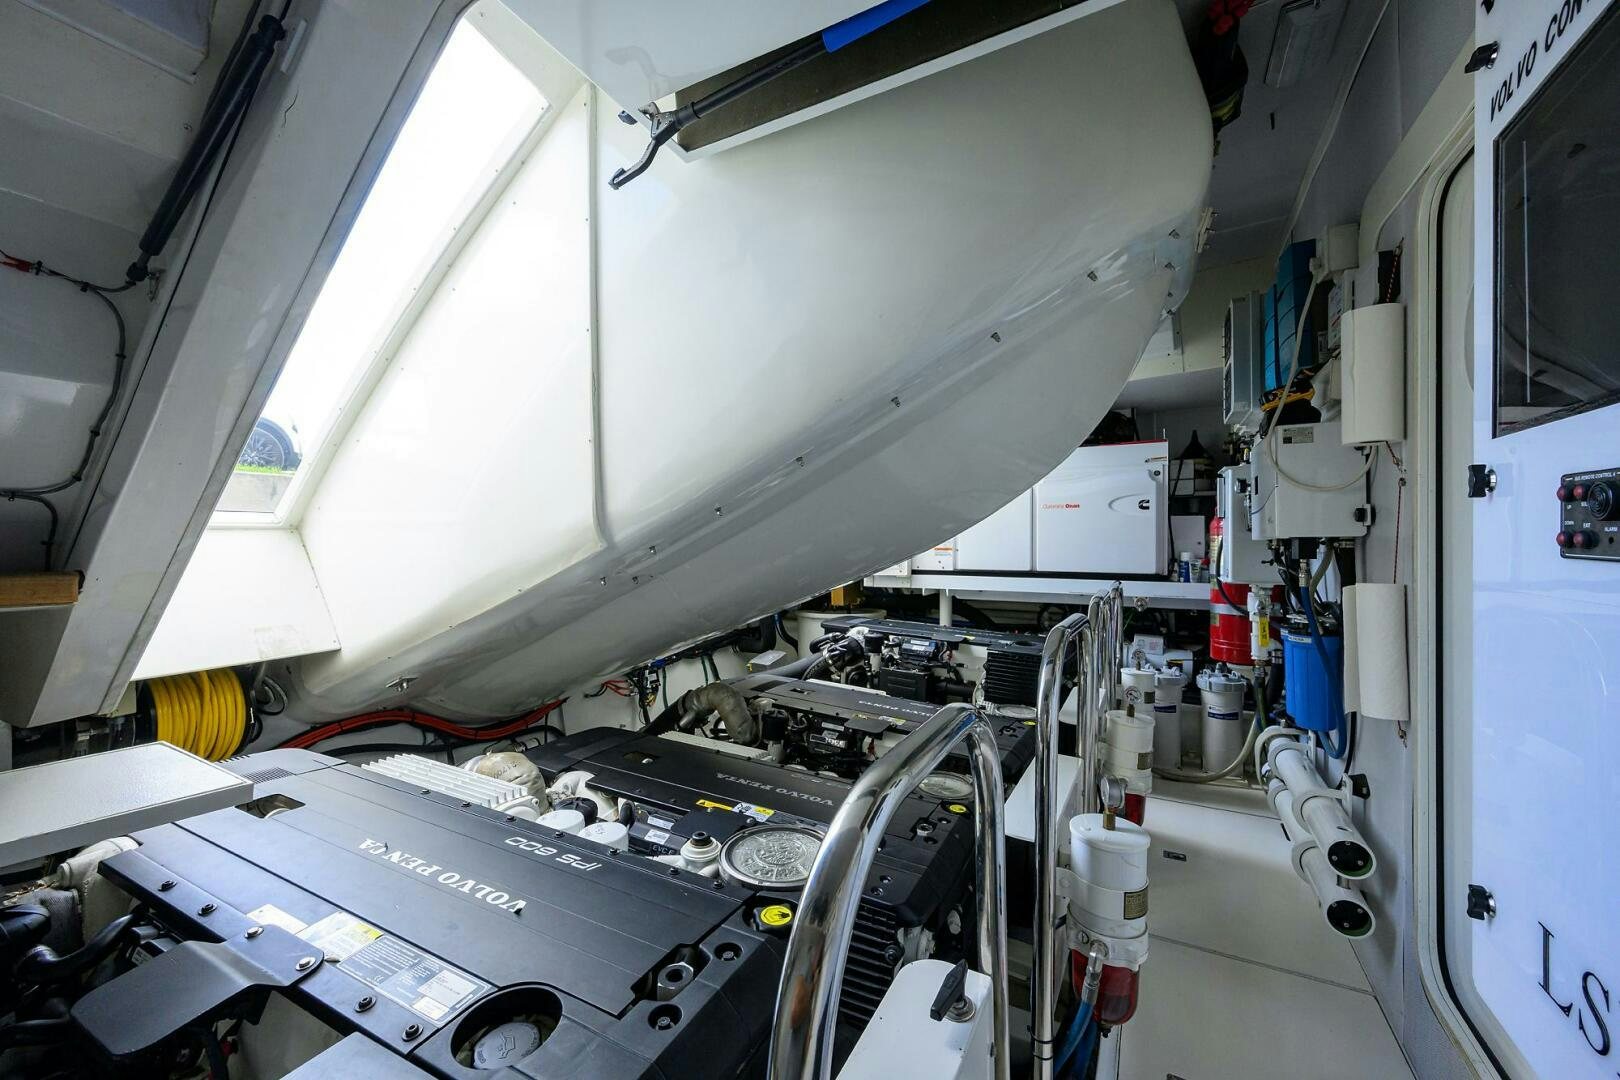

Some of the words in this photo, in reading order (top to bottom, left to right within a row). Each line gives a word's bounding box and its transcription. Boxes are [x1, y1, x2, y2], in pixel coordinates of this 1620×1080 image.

[1490, 40, 1537, 122] VOLVO
[1544, 0, 1589, 53] CON
[504, 836, 558, 856] 600
[555, 853, 602, 872] IPS
[437, 872, 528, 915] VOLVO
